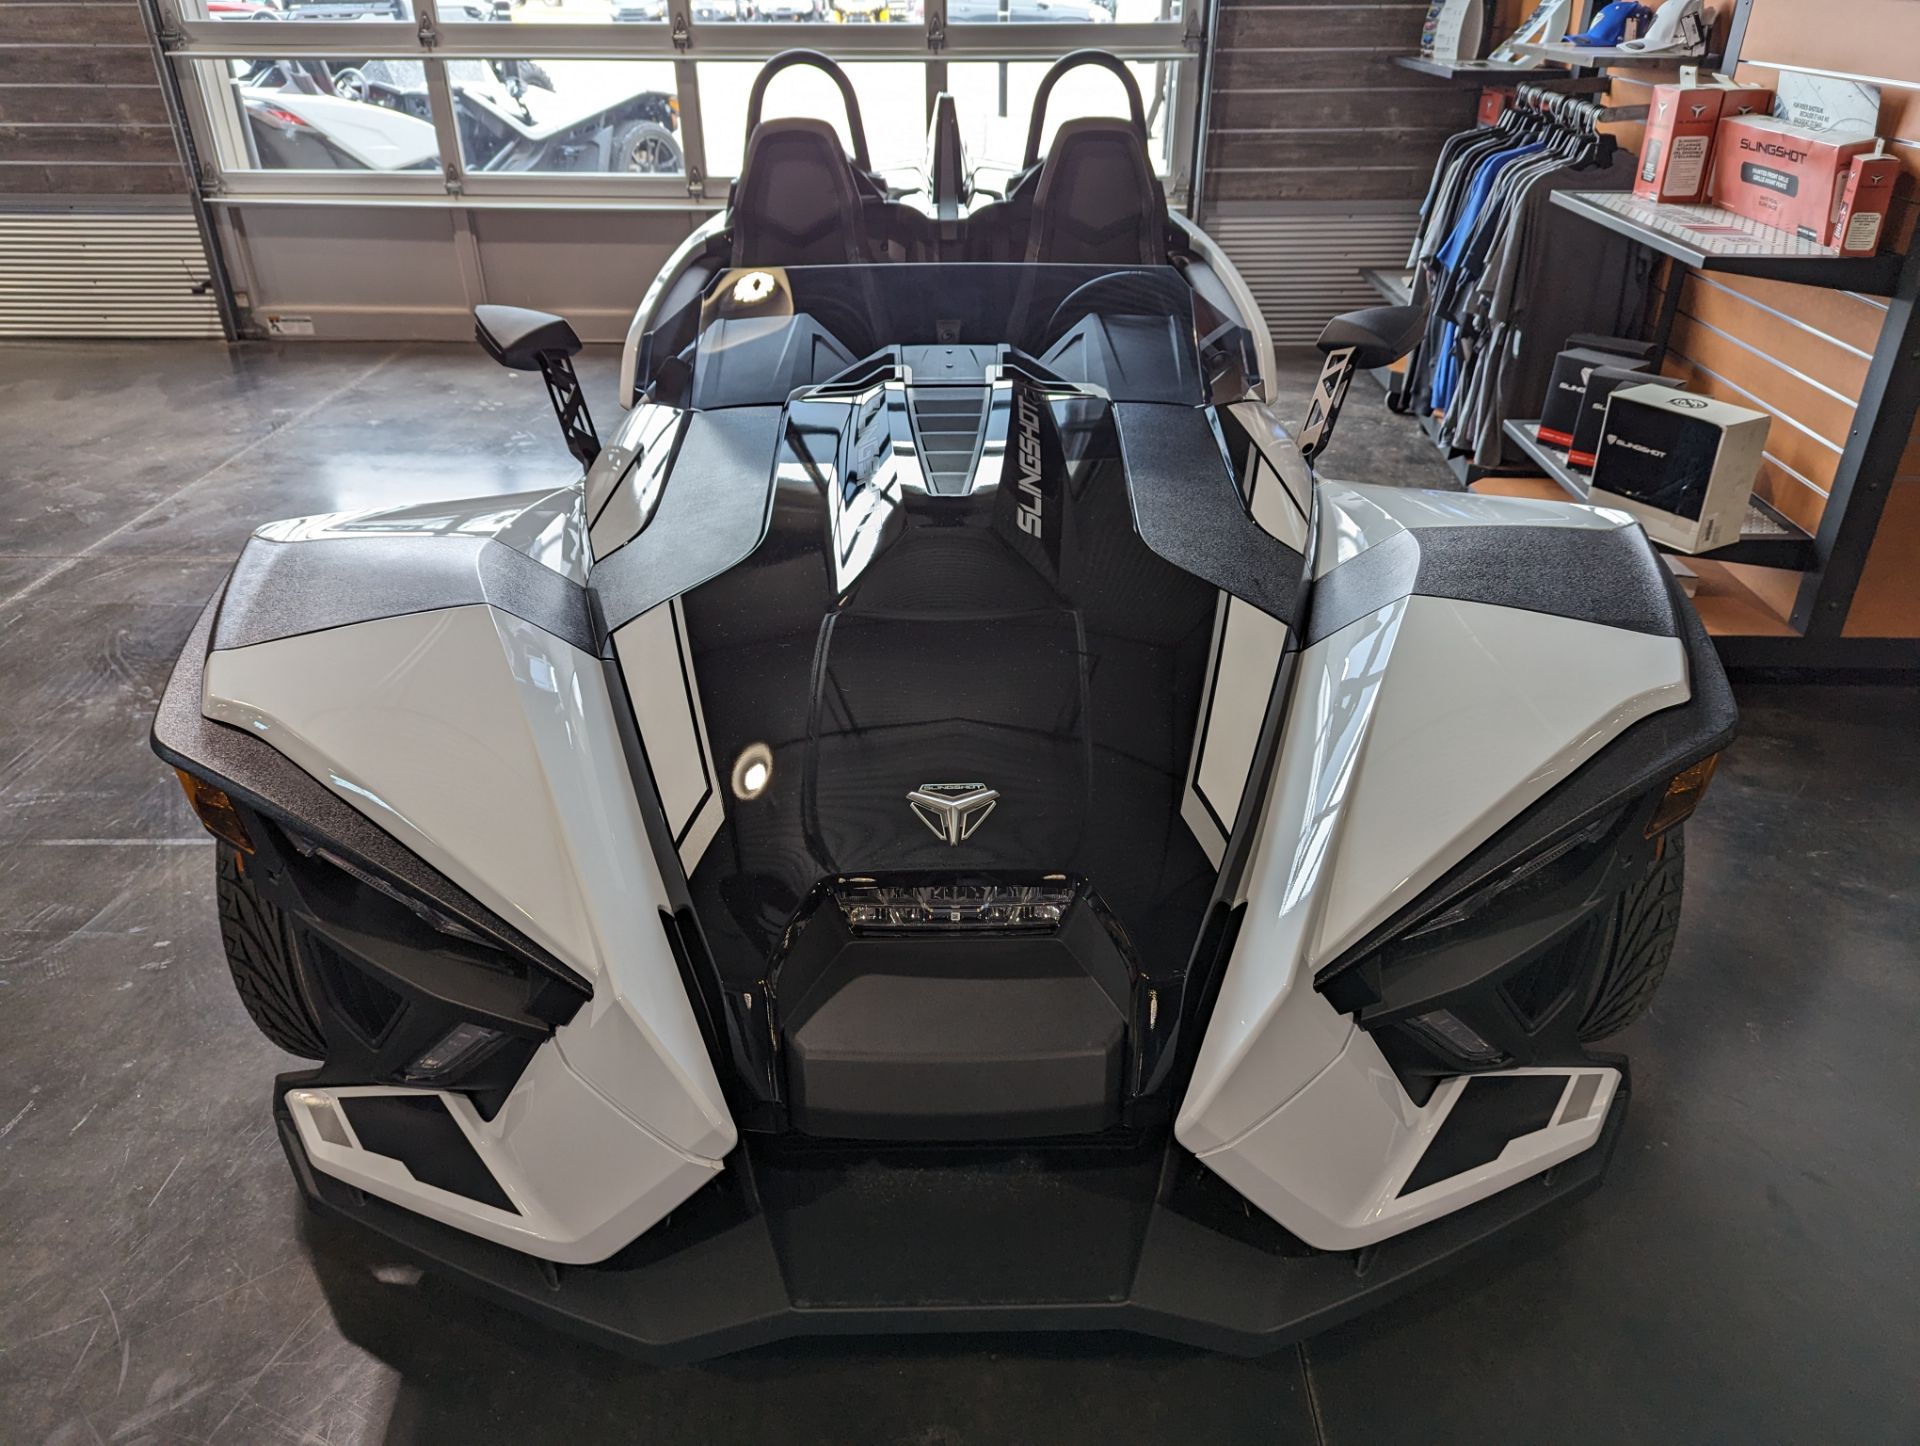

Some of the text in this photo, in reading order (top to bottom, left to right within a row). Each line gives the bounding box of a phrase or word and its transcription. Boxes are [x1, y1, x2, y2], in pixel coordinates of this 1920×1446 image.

[1740, 138, 1807, 164] SLINGSHOT
[1616, 439, 1667, 458] SLINGSHOT
[1016, 395, 1042, 539] SLINGSHOT
